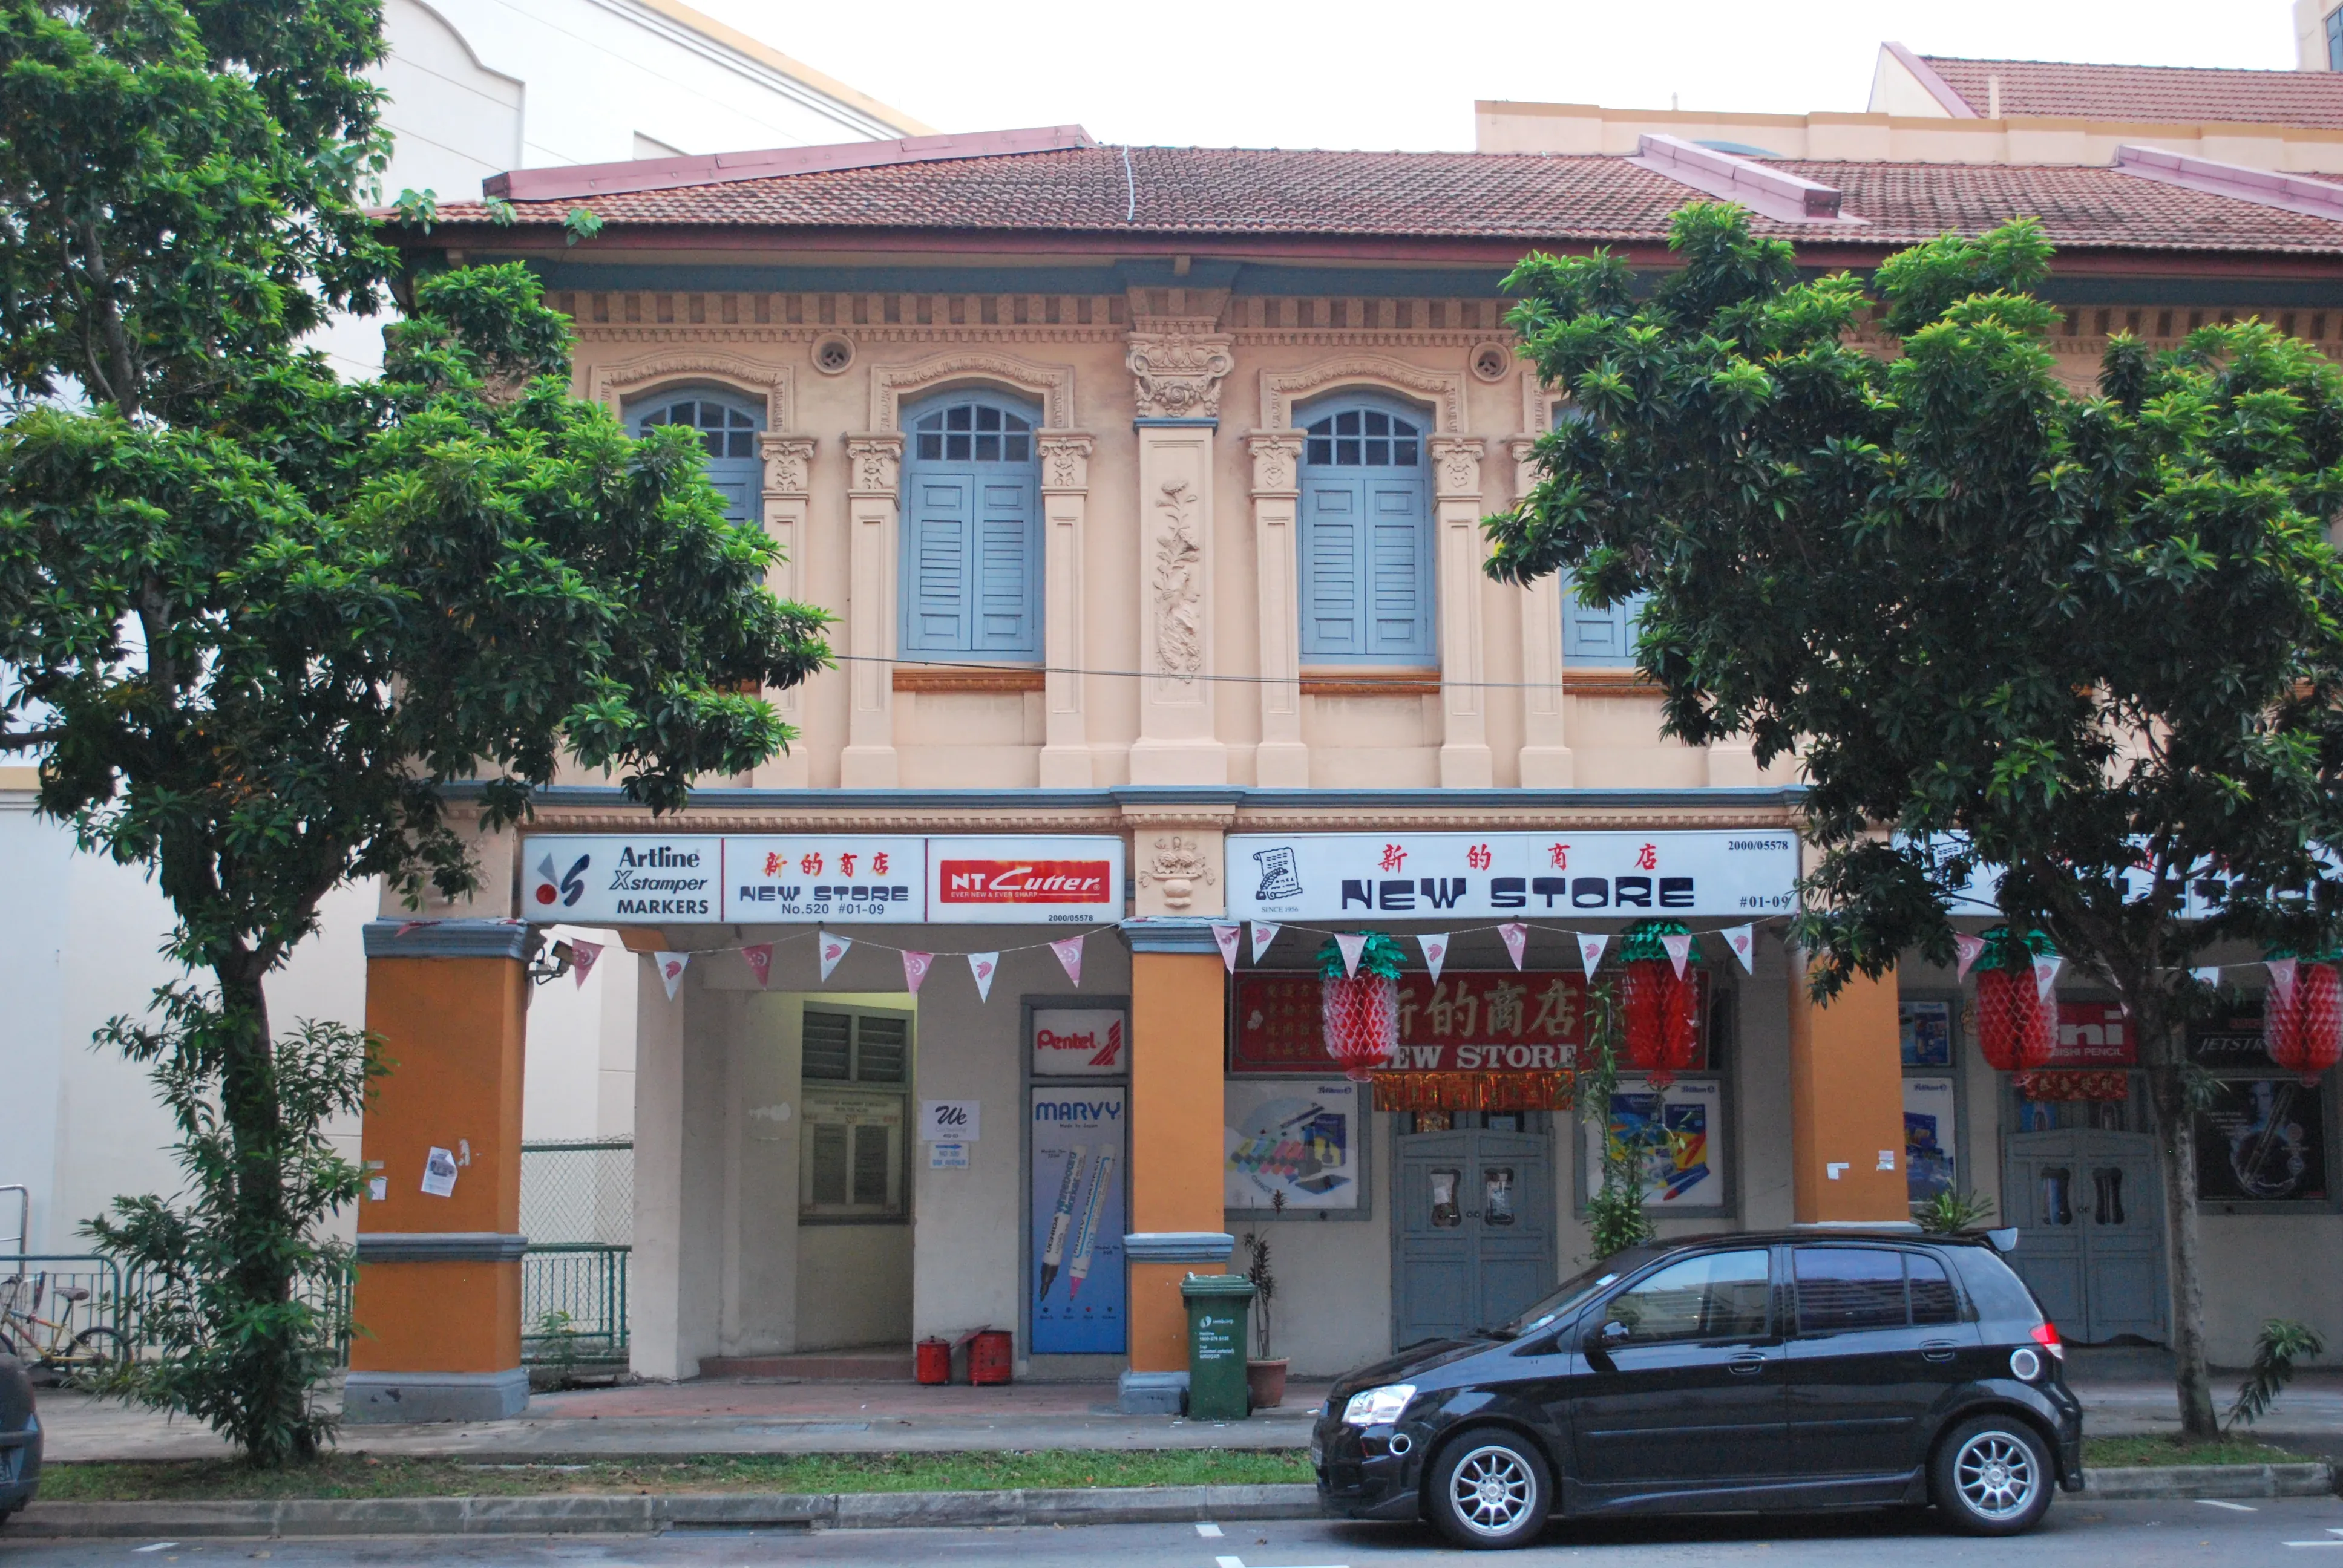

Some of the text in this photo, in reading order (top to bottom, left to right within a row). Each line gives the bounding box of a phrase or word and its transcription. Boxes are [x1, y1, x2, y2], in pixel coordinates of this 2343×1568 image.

[1728, 840, 1788, 851] 2000/05578
[619, 846, 700, 867] Artline
[761, 852, 895, 878] 新的商店
[1378, 843, 1659, 874] 新的商店
[608, 870, 708, 894] Xstamper
[952, 867, 1100, 890] NT Cutter
[740, 886, 908, 901] NEW STORE
[1342, 876, 1694, 910] NEW STORE
[1740, 895, 1790, 907] #01-09
[617, 899, 709, 914] MARKERS
[782, 904, 885, 915] No.520 #01-09
[2059, 1010, 2124, 1045] ni
[1037, 1029, 1097, 1050] Pentel
[1369, 1045, 1578, 1070] EW STORE
[2084, 1047, 2124, 1056] PENCIL
[935, 1105, 968, 1125] We
[1036, 1102, 1121, 1121] MARVY
